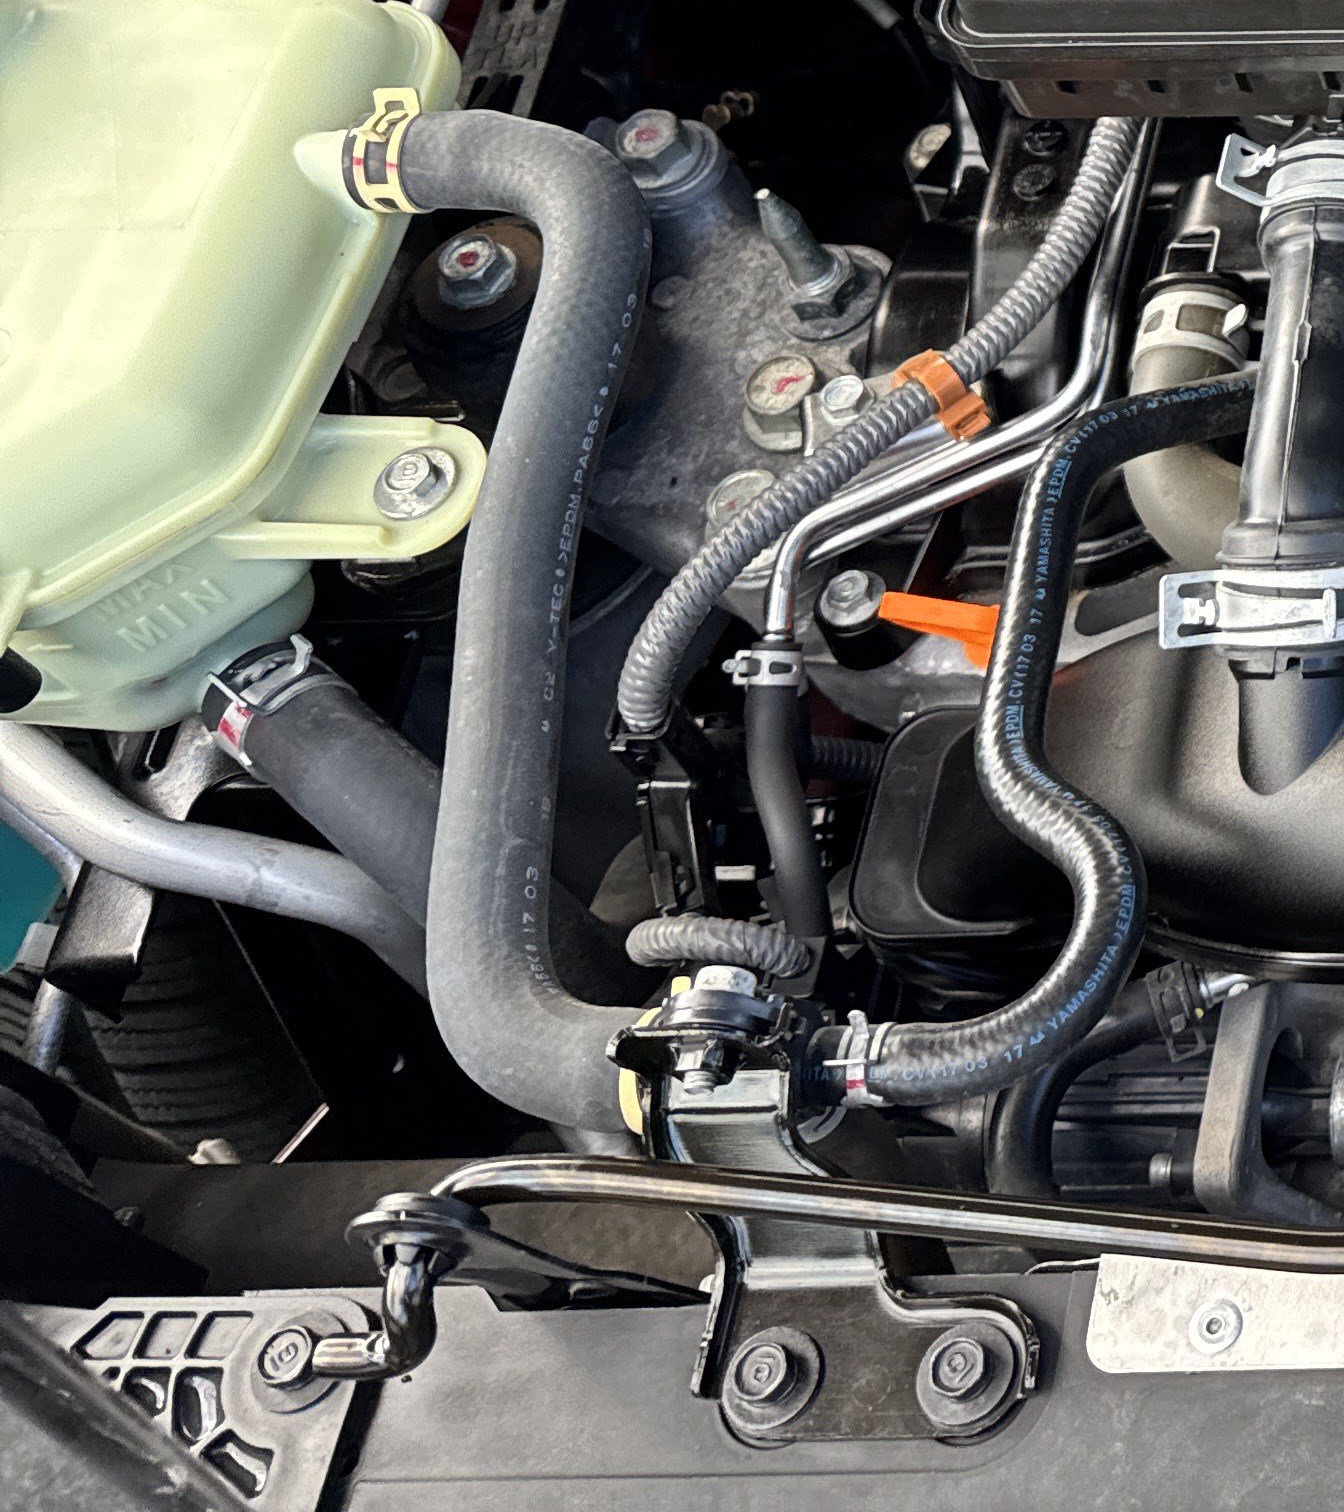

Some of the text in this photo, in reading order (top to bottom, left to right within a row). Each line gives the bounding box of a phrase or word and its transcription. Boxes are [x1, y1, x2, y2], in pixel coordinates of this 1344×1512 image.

[1035, 507, 1056, 584] YAMASHITA
[115, 579, 232, 653] MIN
[1009, 746, 1062, 793] YAMASHITA
[523, 865, 540, 899] 03
[1047, 944, 1119, 1031] YAMASHITA
[1003, 1045, 1024, 1063] 17
